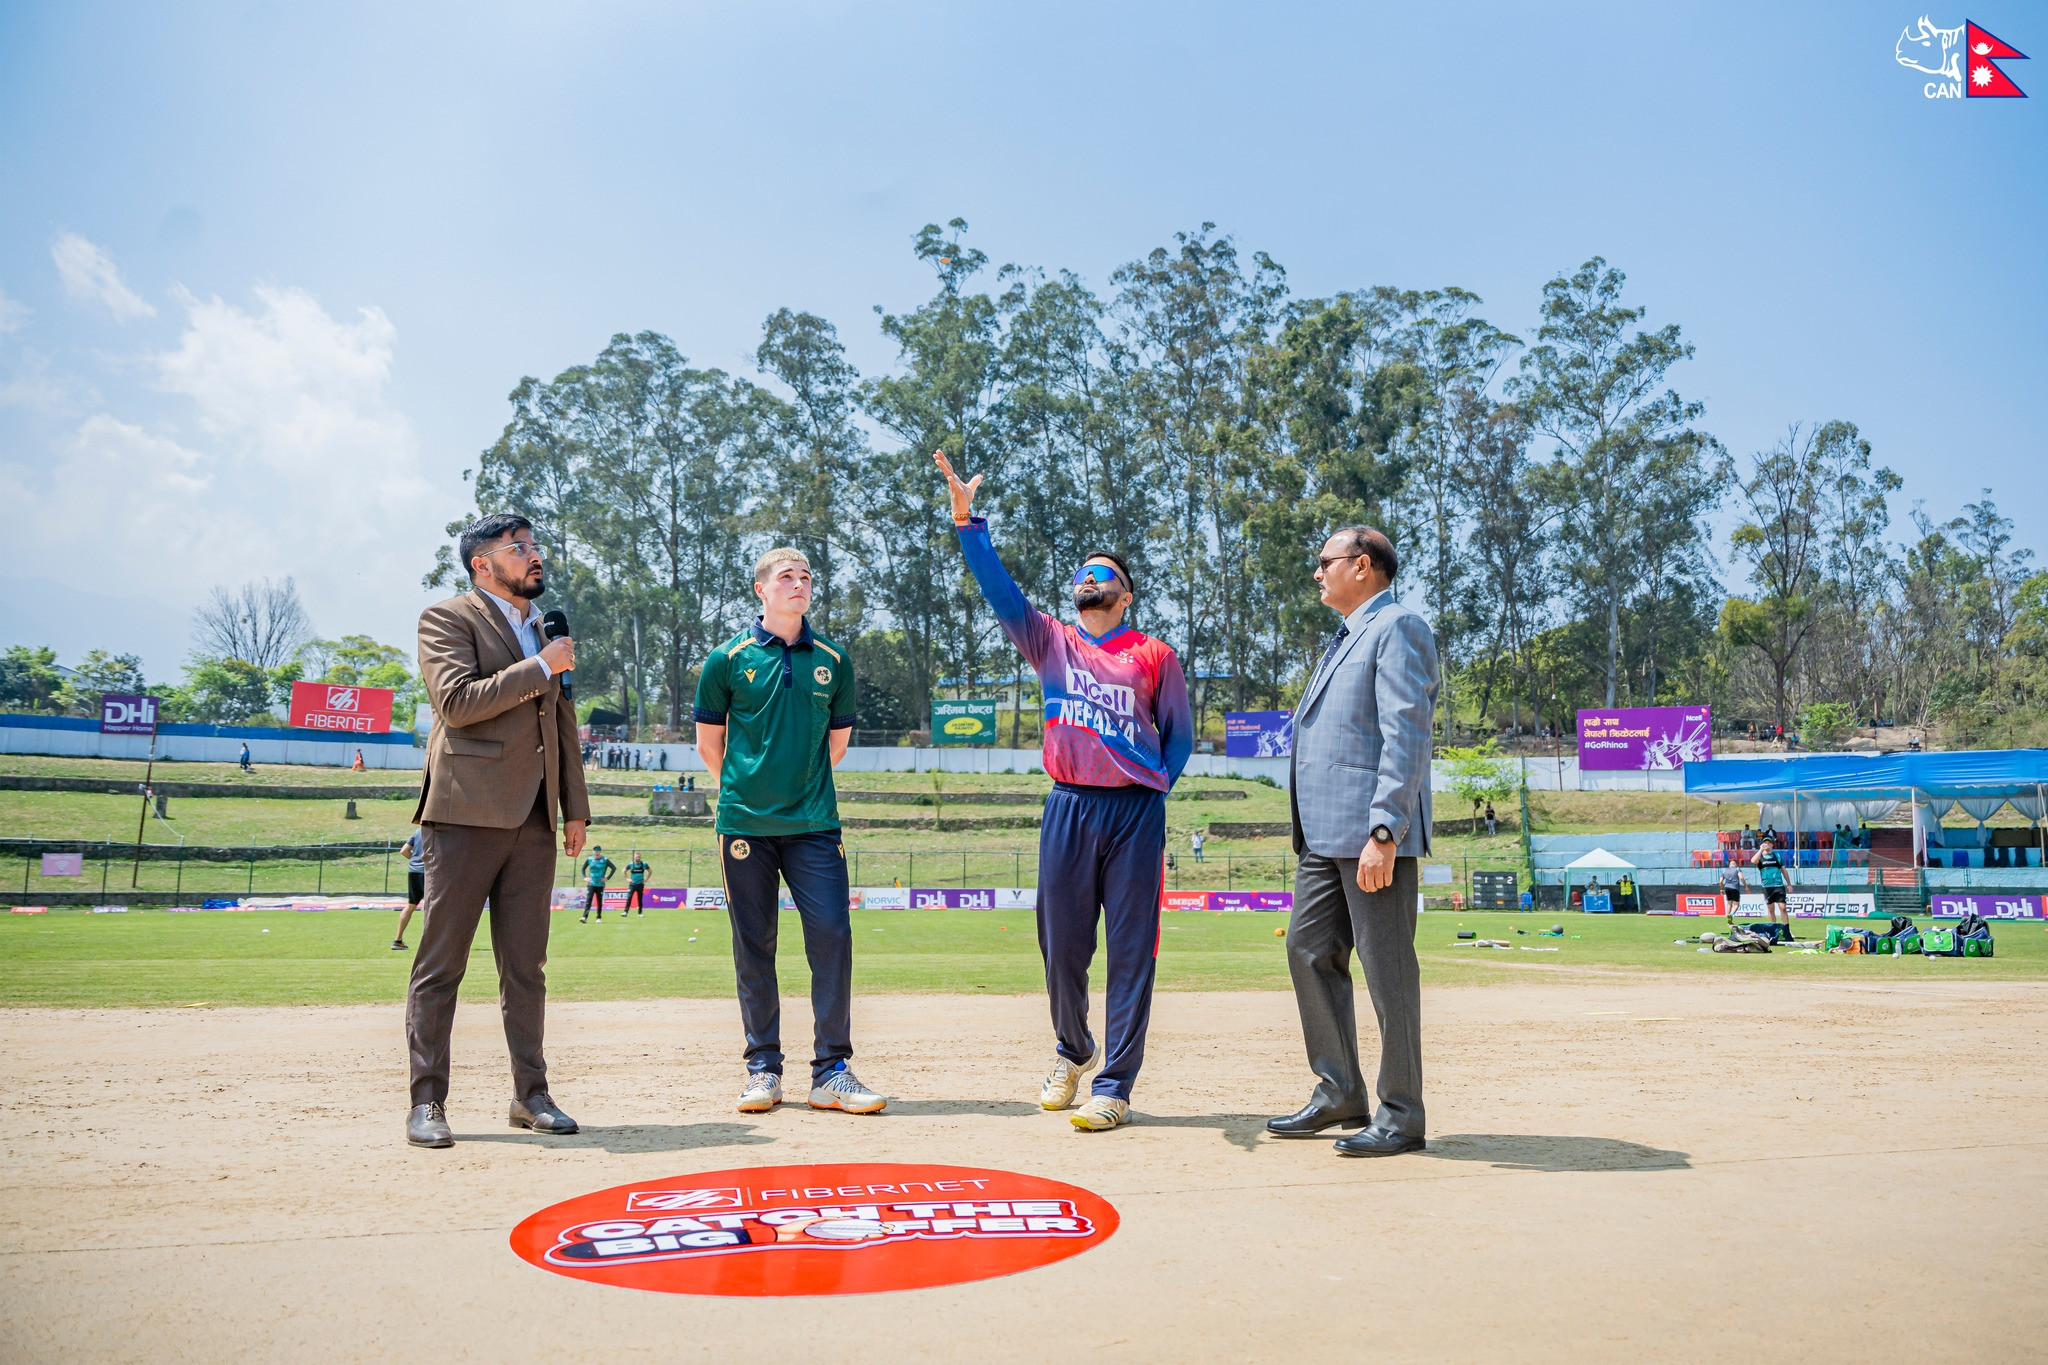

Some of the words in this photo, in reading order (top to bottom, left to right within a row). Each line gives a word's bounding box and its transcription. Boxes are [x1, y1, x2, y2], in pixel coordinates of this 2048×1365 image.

[304, 713, 375, 731] FIBERNET
[1058, 700, 1117, 737] NEPAL
[1584, 741, 1628, 749] #GoRhinos
[694, 896, 727, 906] SPO
[1862, 903, 1869, 913] 1
[760, 1179, 990, 1201] FIBERNET
[581, 1206, 881, 1240] CATCH
[893, 1201, 1063, 1219] THE
[592, 1229, 742, 1257] BIG
